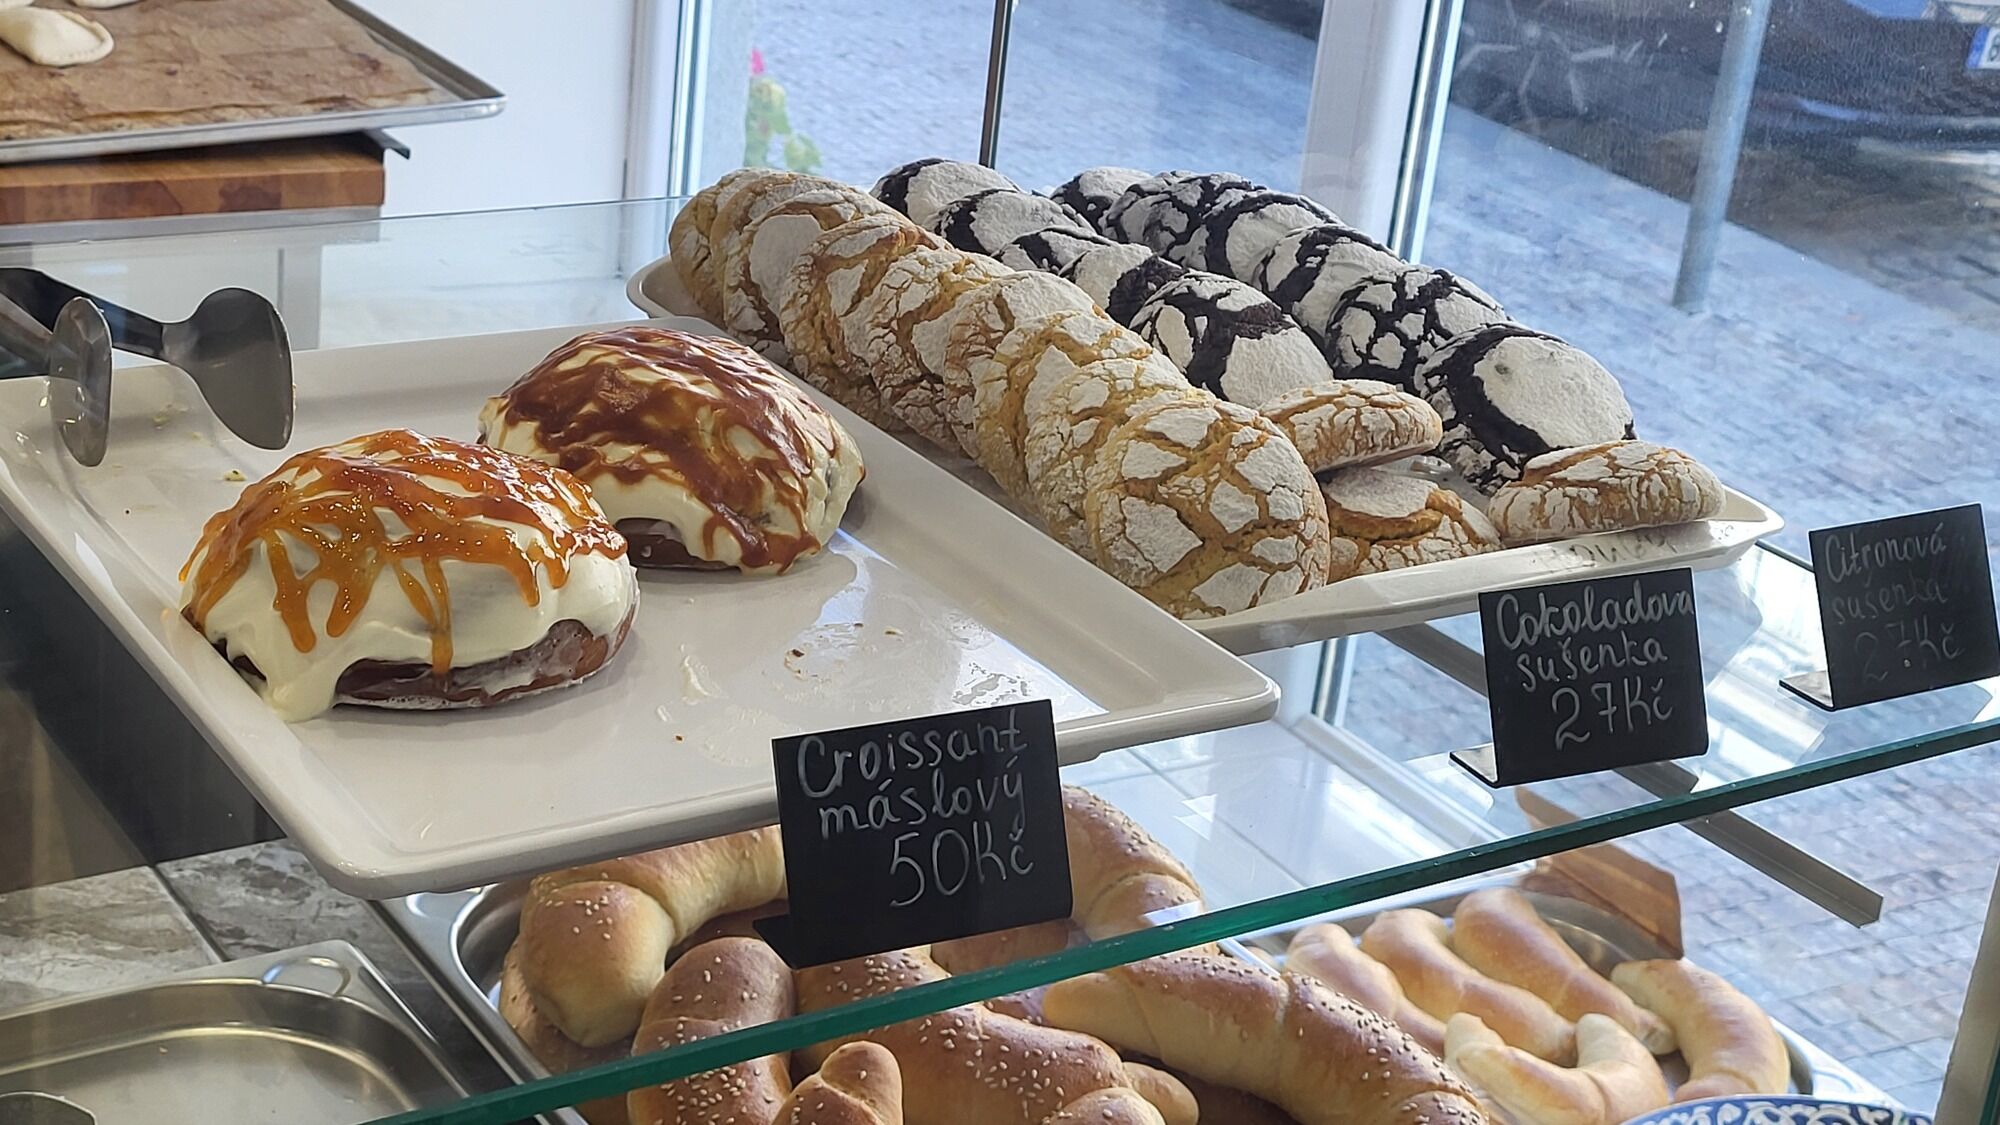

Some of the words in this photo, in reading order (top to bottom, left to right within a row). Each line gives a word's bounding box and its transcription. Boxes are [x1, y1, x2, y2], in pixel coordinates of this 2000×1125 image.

[1825, 523, 1947, 583] Citronová
[1496, 579, 1695, 650] Cokoladova
[1517, 631, 1669, 692] sušenka
[1552, 675, 1673, 750] 27Kč
[797, 708, 1028, 798] Croissant
[819, 756, 1027, 839] máslový
[889, 820, 1035, 907] 50Kč
